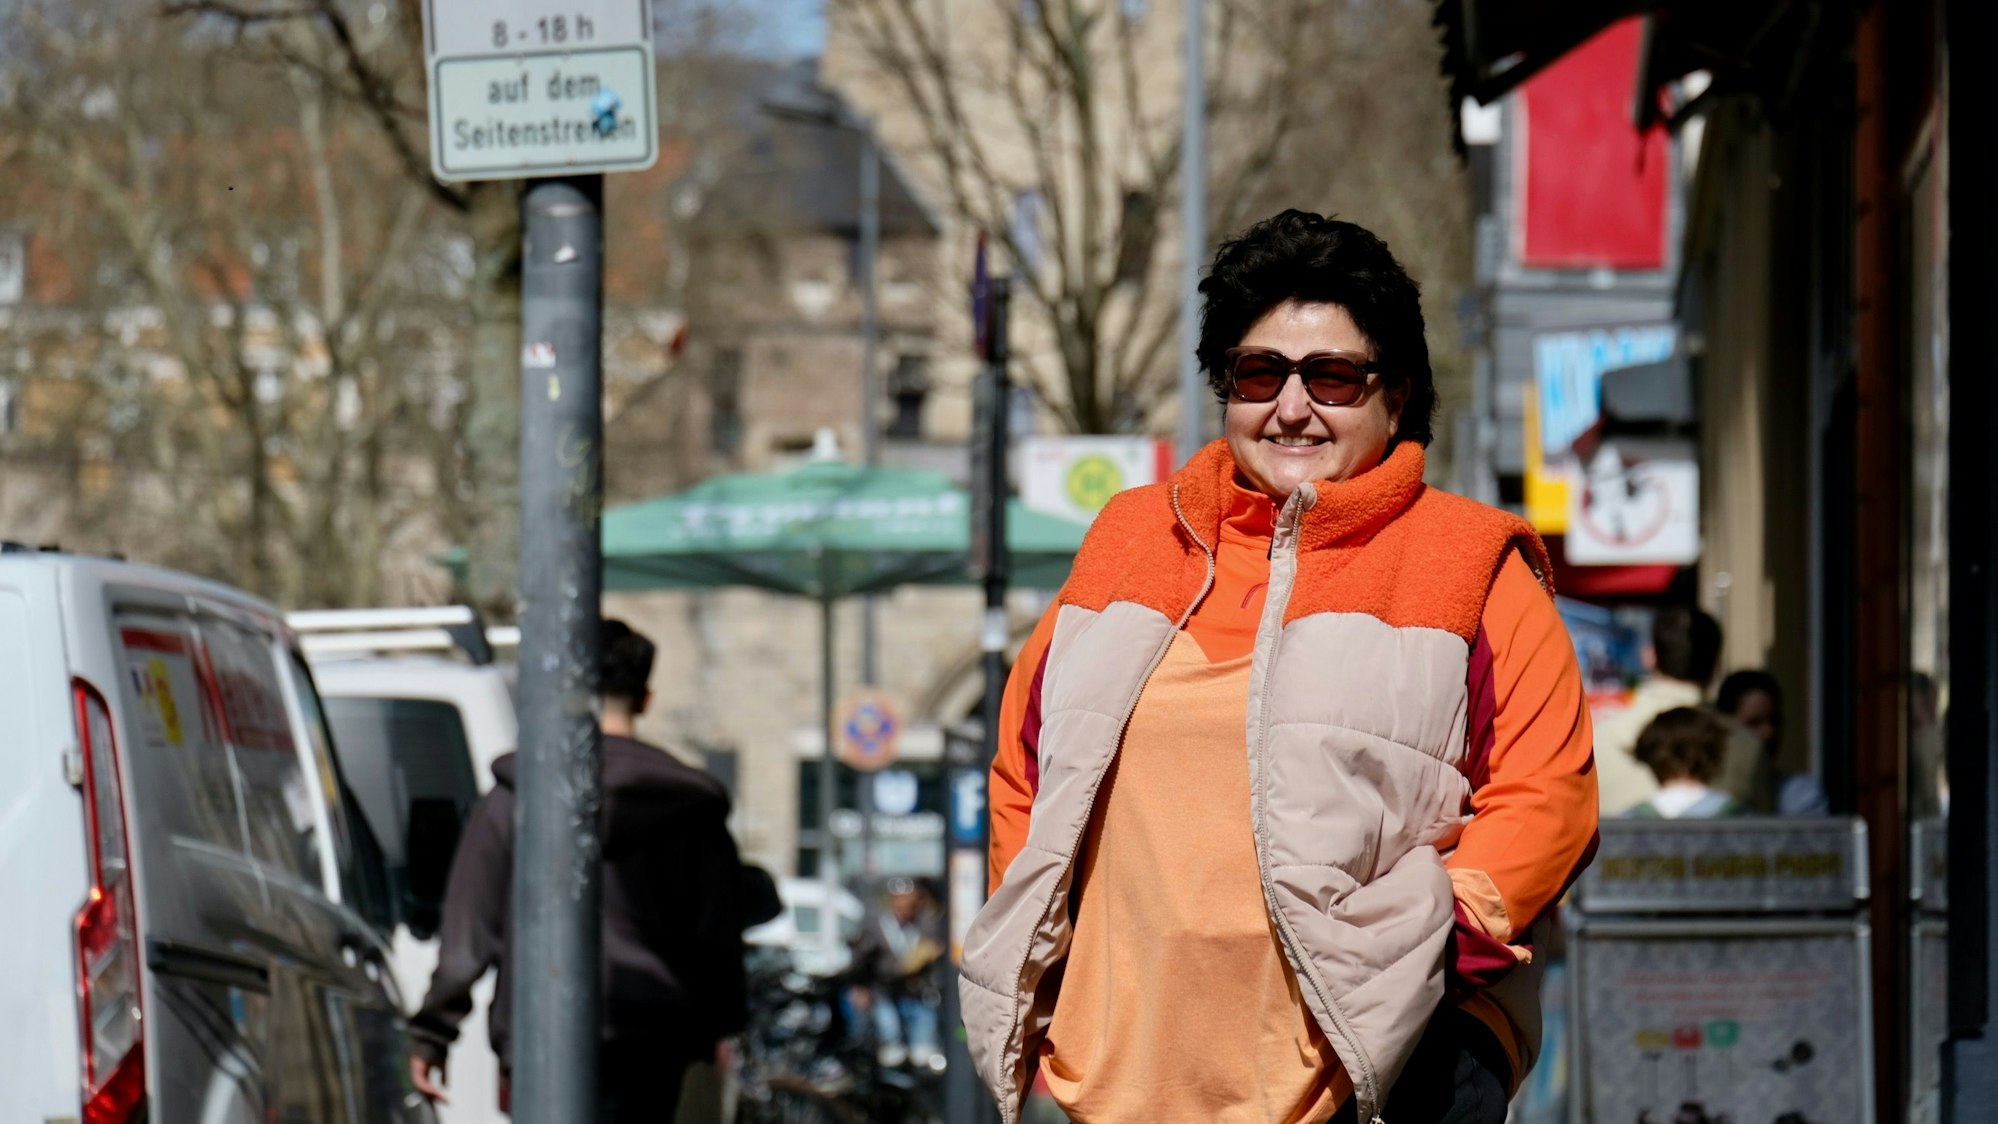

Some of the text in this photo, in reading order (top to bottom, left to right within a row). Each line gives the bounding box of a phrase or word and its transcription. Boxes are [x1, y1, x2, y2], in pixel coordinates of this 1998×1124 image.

[491, 19, 508, 48] 8
[538, 14, 568, 43] 18
[577, 13, 594, 41] h
[488, 70, 601, 103] auf dem
[453, 115, 636, 149] Seitenstreen
